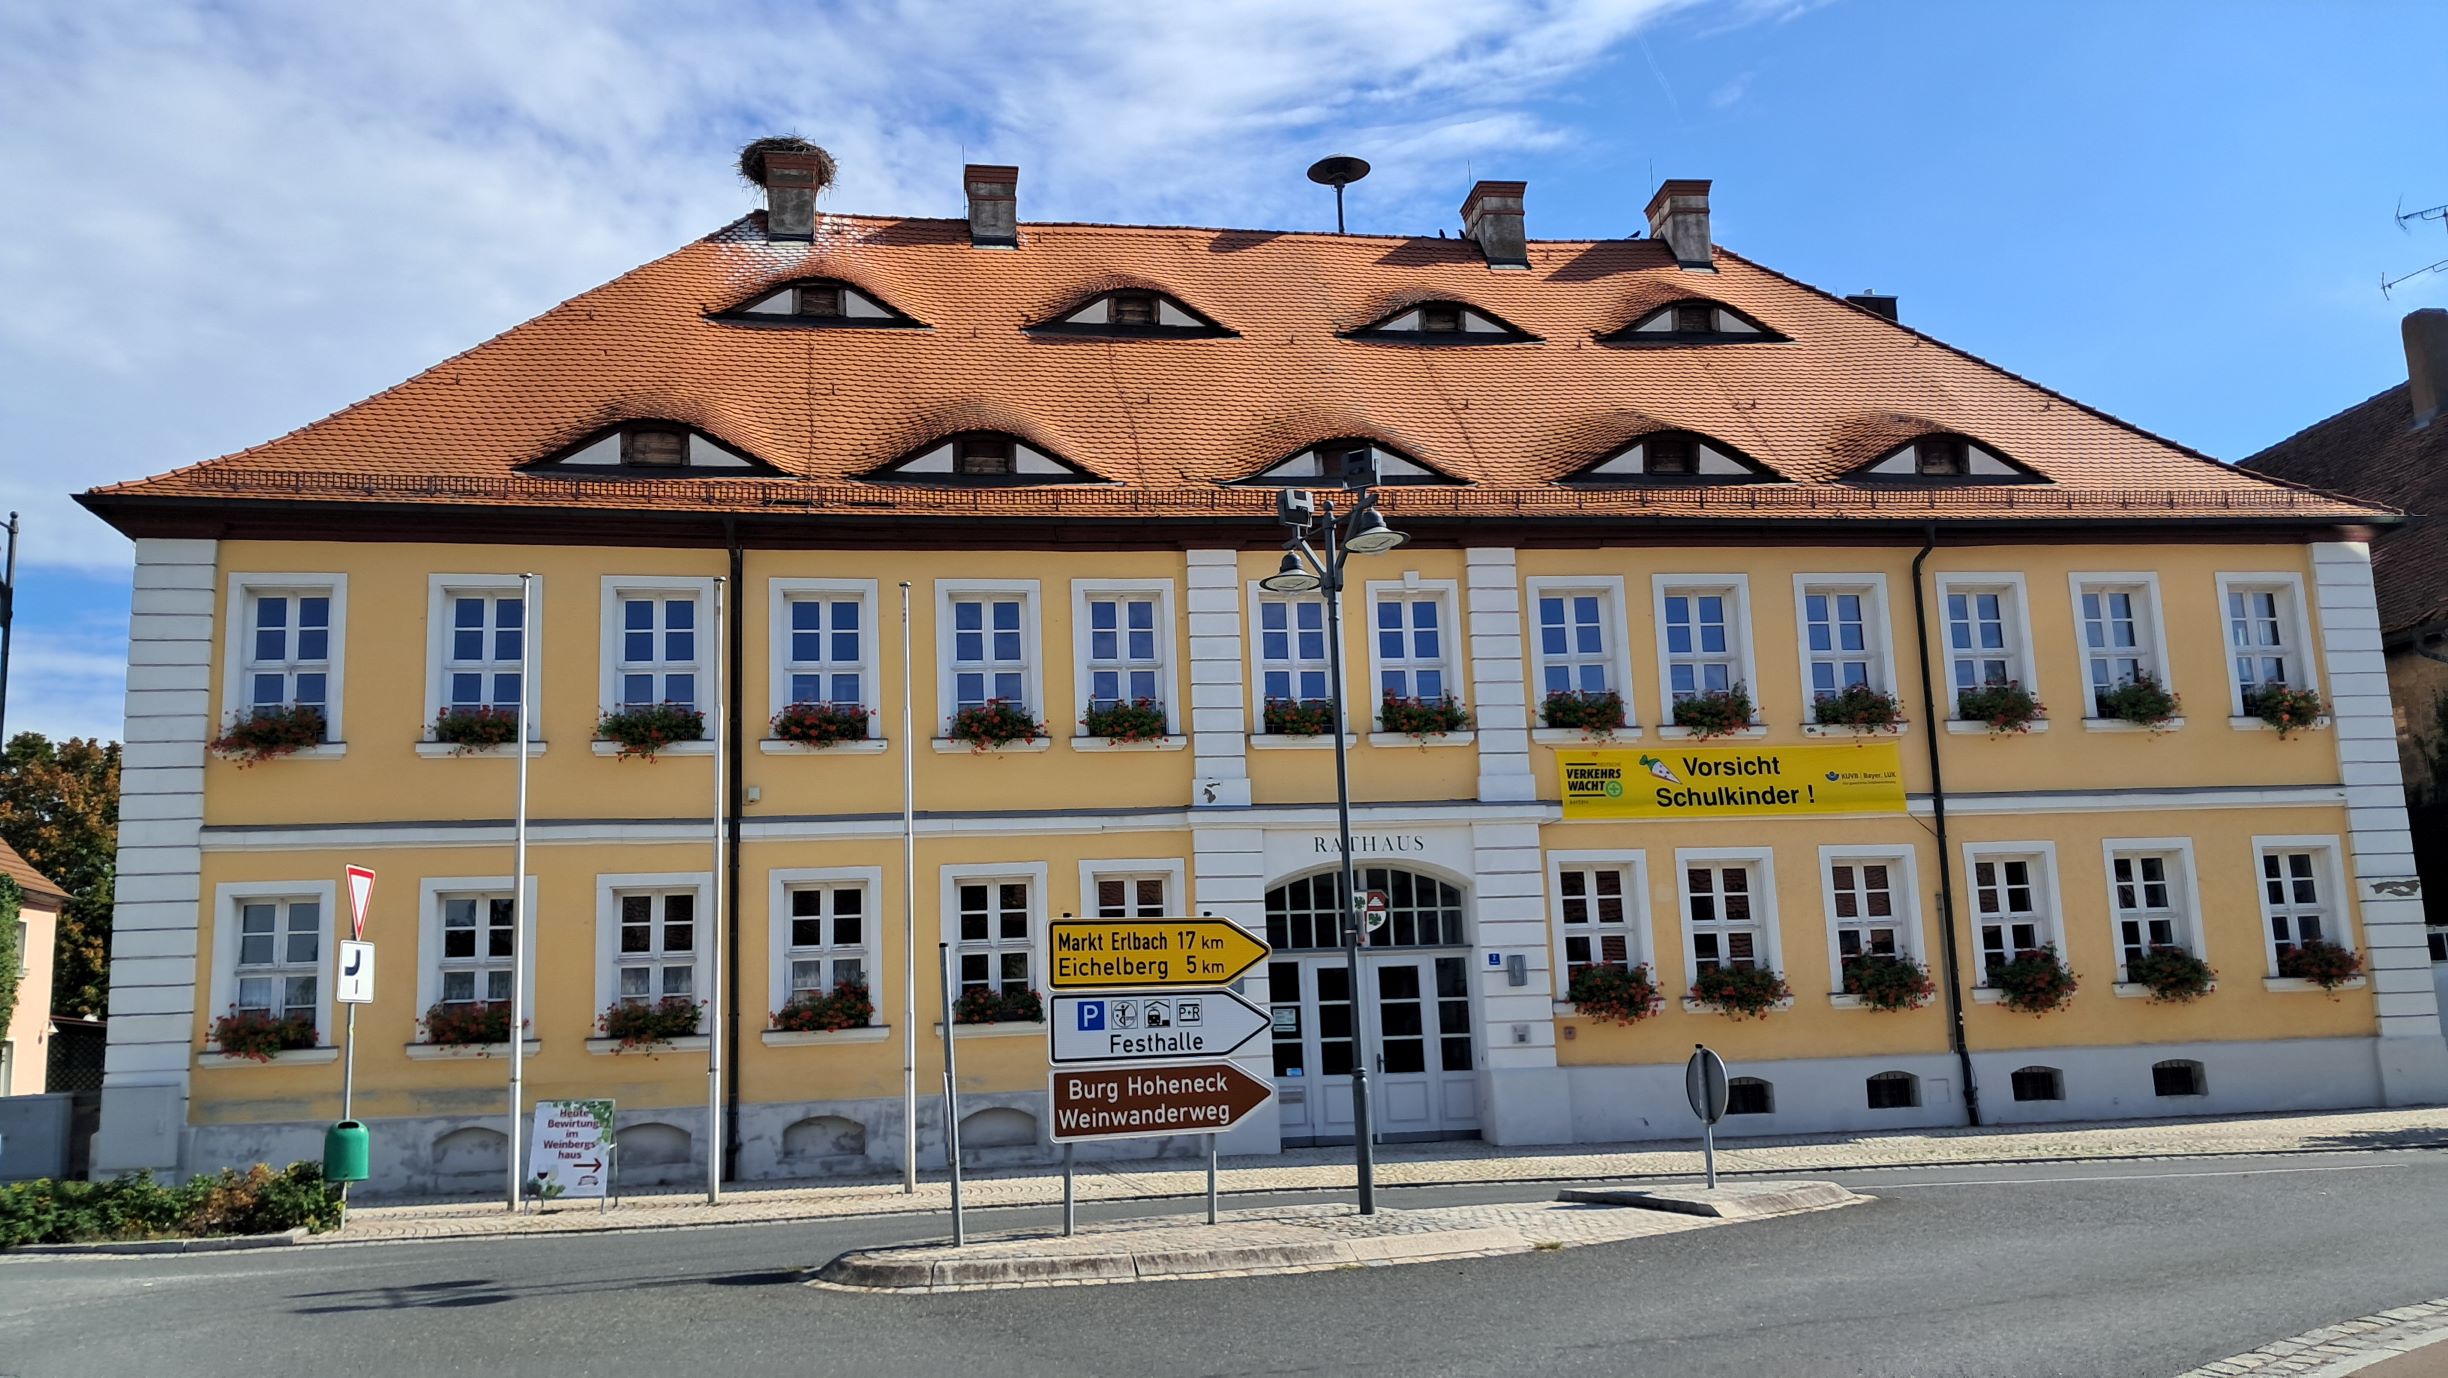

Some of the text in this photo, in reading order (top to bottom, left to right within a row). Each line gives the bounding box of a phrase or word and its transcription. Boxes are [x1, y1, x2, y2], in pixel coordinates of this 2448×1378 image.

[1566, 768, 1622, 779] VERKEHRS
[1683, 756, 1780, 777] Vorsicht
[1568, 780, 1606, 791] WACHT
[1656, 784, 1815, 808] Schulkinder !
[1314, 835, 1425, 853] RATHAUS
[1058, 931, 1224, 951] Markt Erlbach 17 km
[1059, 955, 1225, 979] Eichelberg 5 km
[1083, 1004, 1098, 1027] P
[1110, 1032, 1204, 1054] Festhalle
[1069, 1072, 1228, 1103] Burg Hoheneck
[559, 1109, 590, 1118] Heute
[1058, 1104, 1230, 1130] Weinwanderweg
[547, 1119, 600, 1130] Bewirtung
[565, 1130, 579, 1139] im
[558, 1151, 582, 1159] haus
